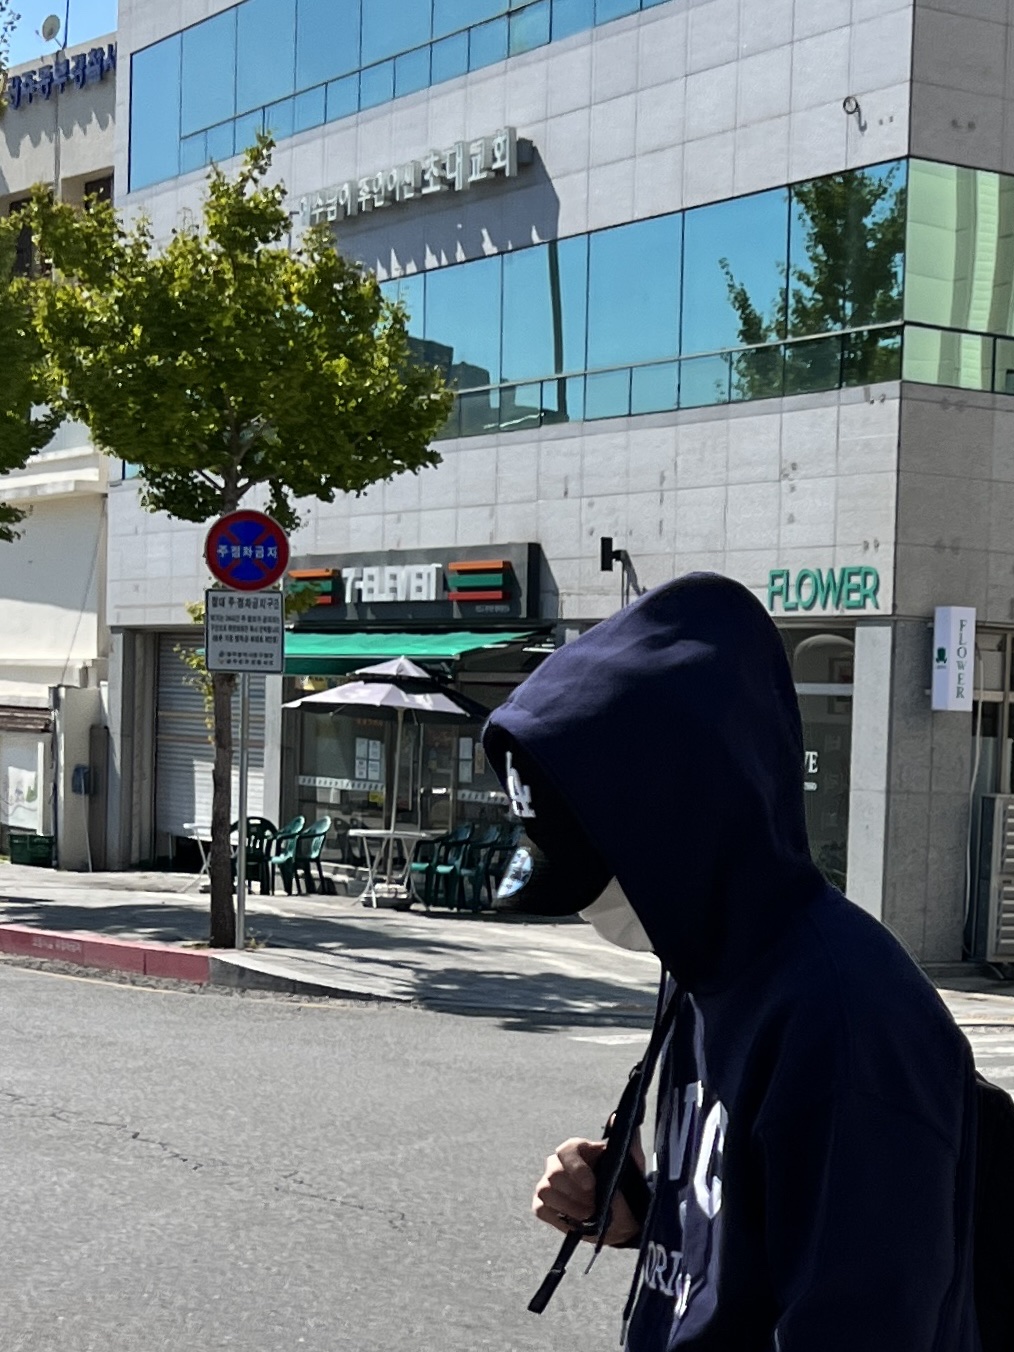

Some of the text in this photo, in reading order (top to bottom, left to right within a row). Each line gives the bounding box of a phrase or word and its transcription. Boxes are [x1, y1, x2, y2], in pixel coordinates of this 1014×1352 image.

[421, 126, 516, 196] 초대교회
[768, 566, 879, 611] FLOWER
[956, 619, 967, 699] FLOWER
